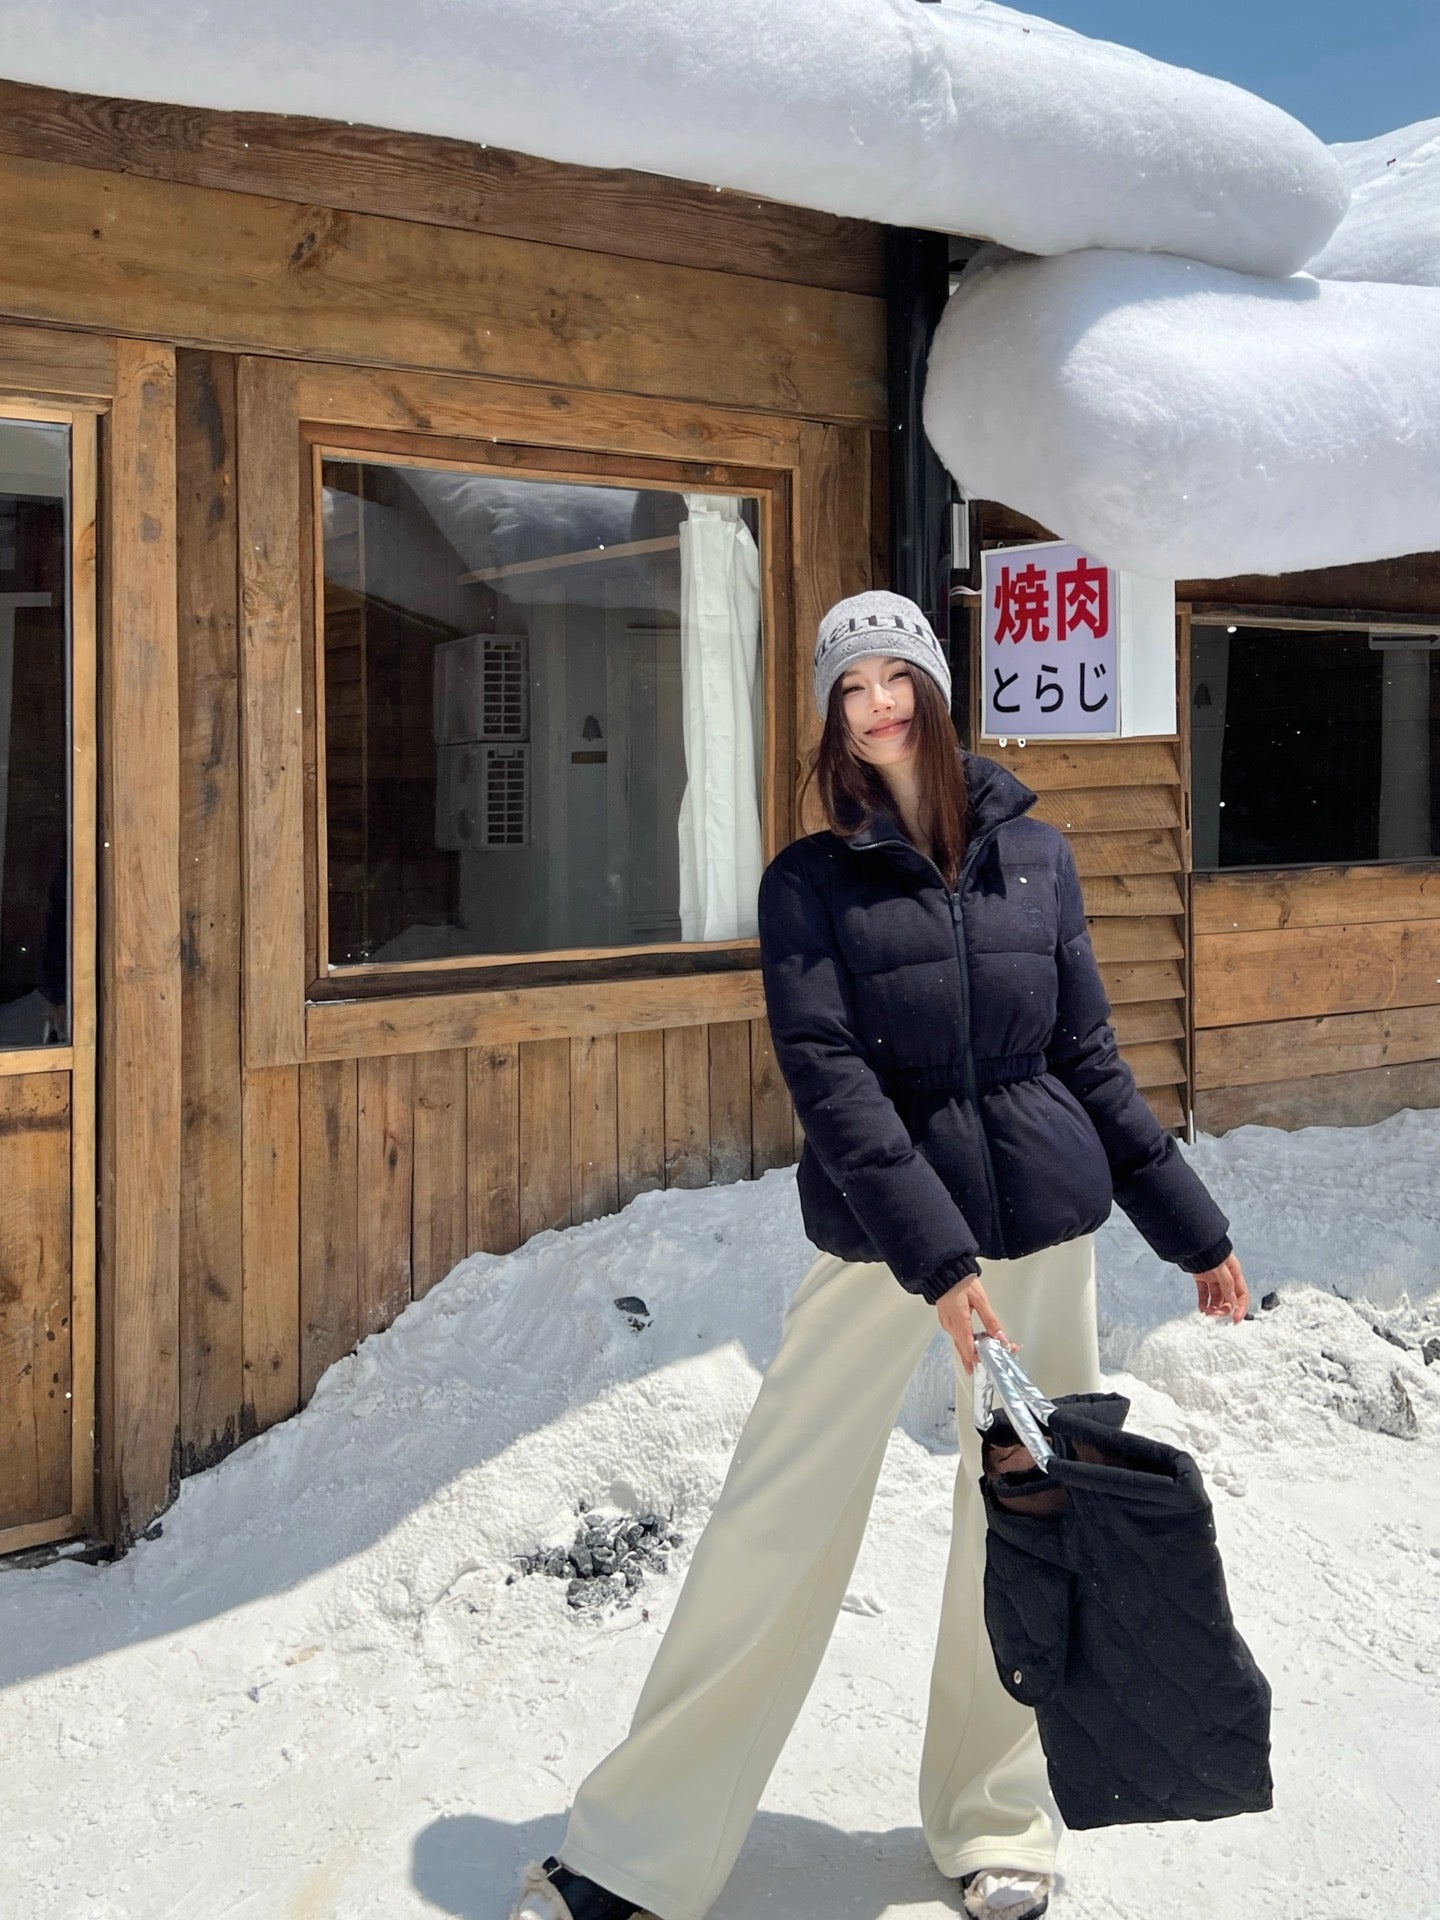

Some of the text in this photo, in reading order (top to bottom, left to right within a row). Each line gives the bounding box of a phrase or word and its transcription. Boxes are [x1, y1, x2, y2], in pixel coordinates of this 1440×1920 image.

[994, 557, 1109, 645] 焼肉
[993, 662, 1109, 713] とらじ
